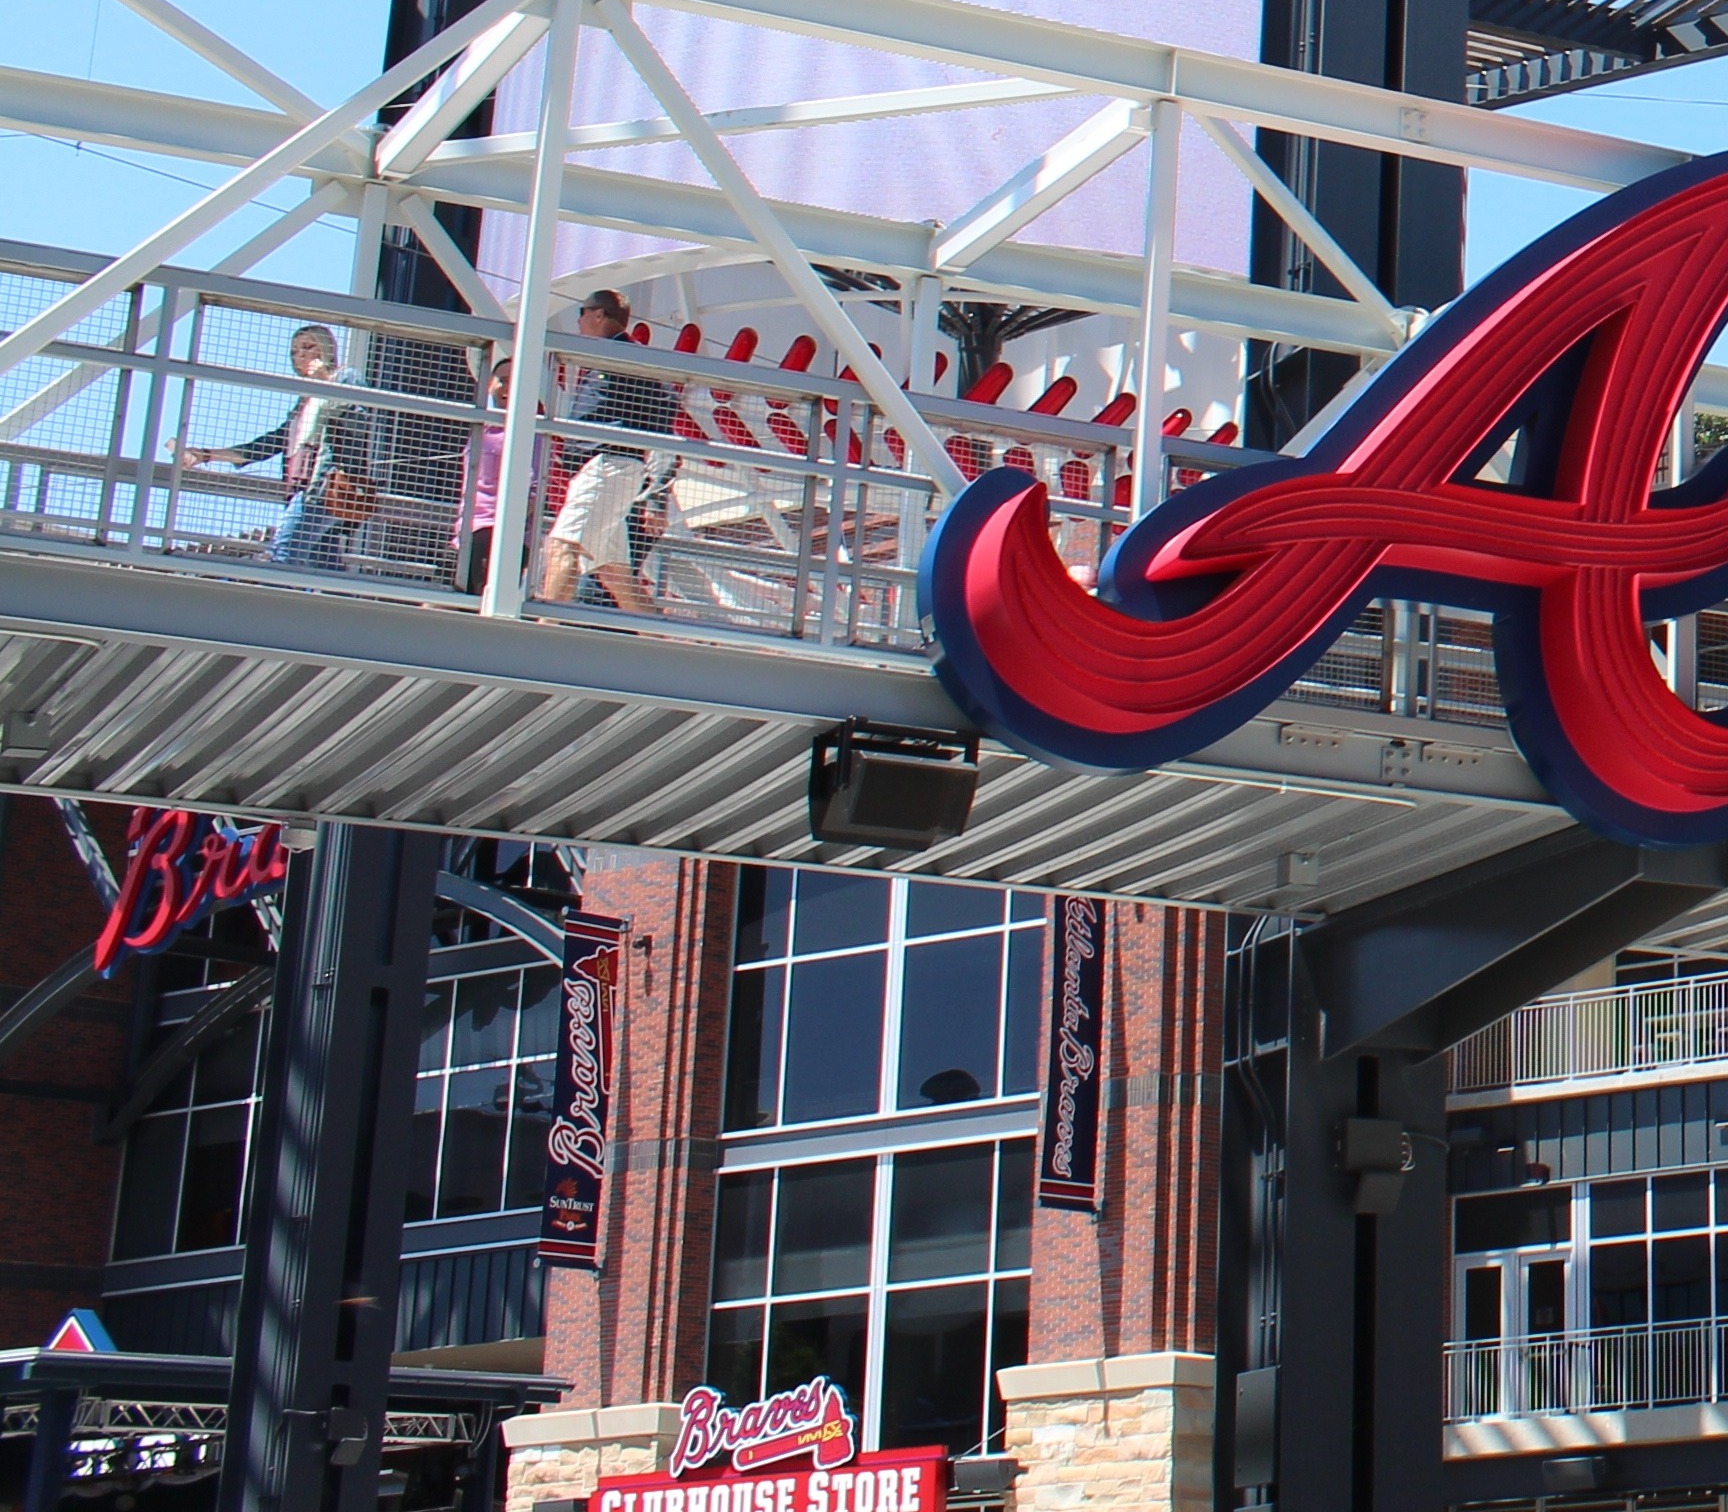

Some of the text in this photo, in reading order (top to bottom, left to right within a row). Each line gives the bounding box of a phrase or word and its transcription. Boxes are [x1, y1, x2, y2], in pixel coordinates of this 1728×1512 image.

[94, 807, 288, 974] Bra
[548, 976, 606, 1179] Braves
[1053, 1028, 1095, 1178] Braves
[670, 1375, 829, 1478] Braves
[807, 1466, 921, 1512] STORE
